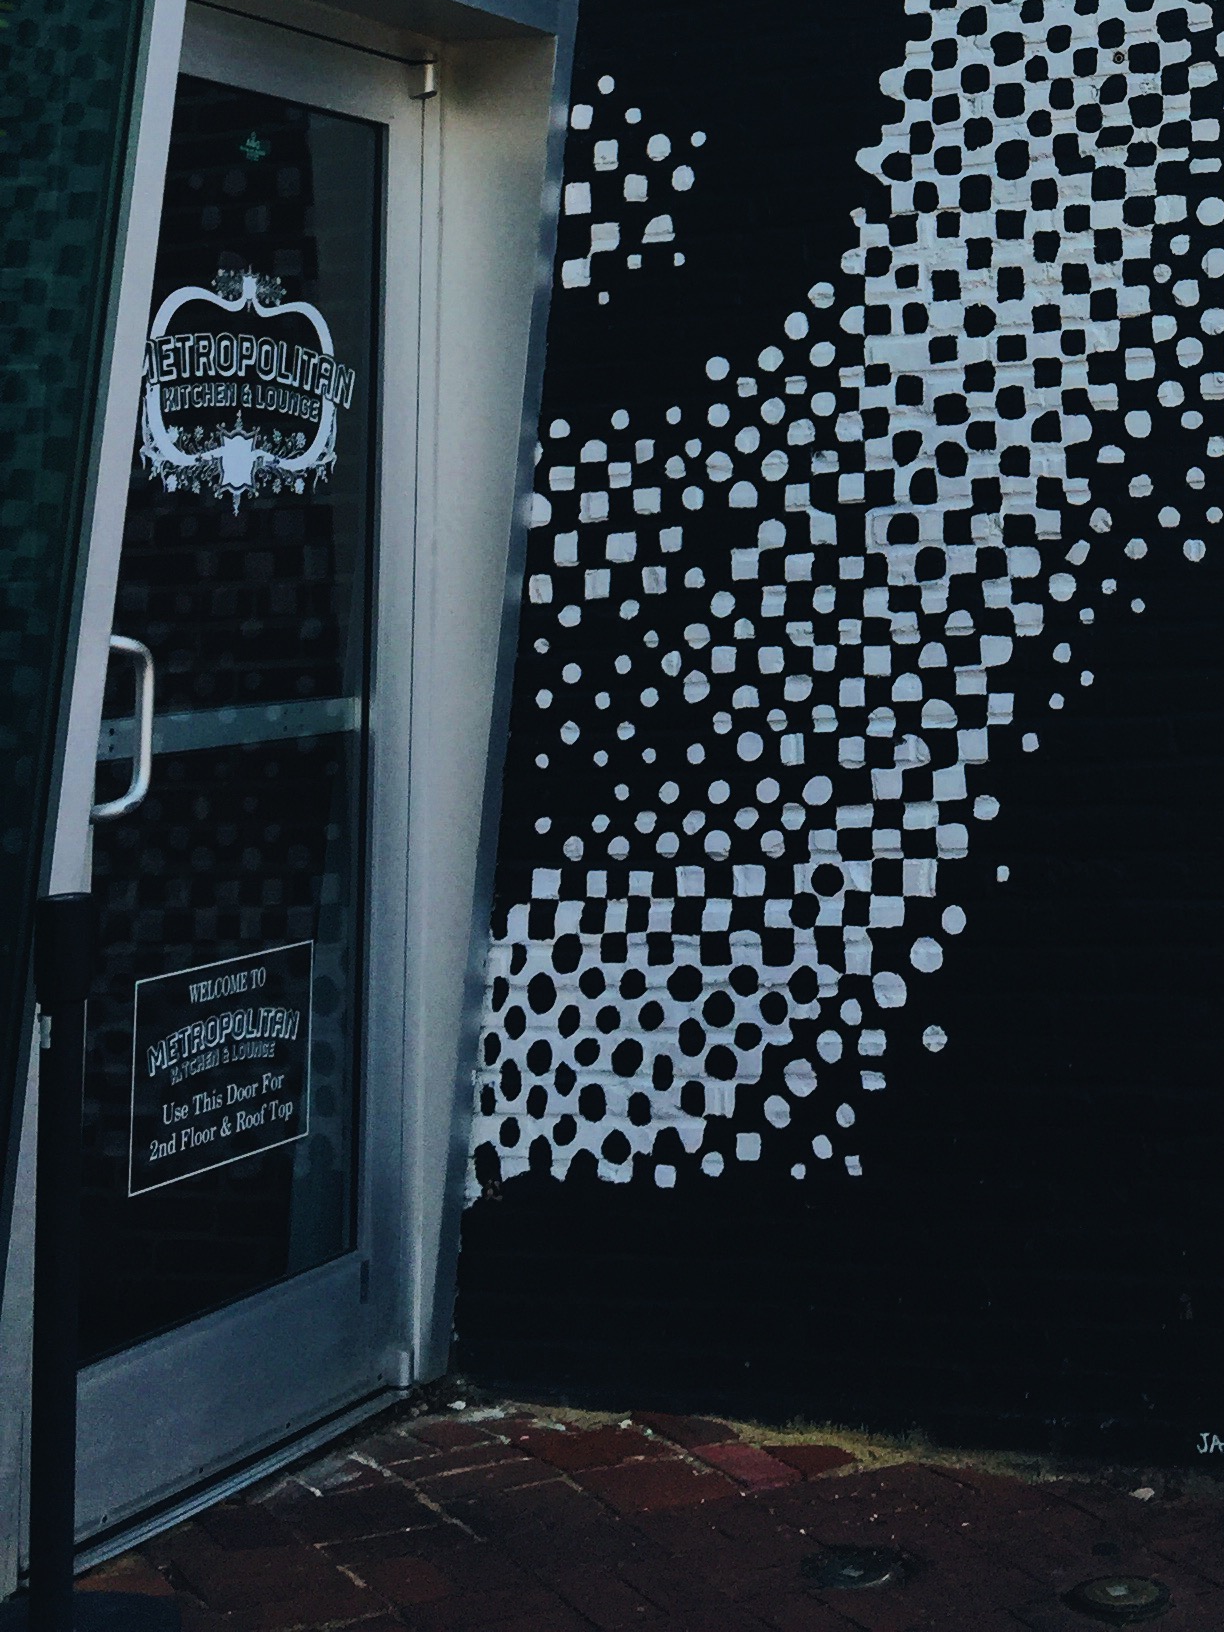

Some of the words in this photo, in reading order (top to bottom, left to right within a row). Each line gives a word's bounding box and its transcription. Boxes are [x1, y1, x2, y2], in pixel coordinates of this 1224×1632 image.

[162, 382, 237, 413] KITCHEN
[241, 384, 252, 408] &
[256, 385, 322, 423] LOUNGE
[189, 972, 248, 1003] WELCOME
[250, 967, 267, 989] TO
[147, 1007, 300, 1077] METROPOLITAN
[231, 1041, 276, 1062] LOUNGE
[162, 1103, 189, 1125] Use
[192, 1088, 223, 1116] This
[226, 1083, 259, 1107] Door
[261, 1071, 285, 1095] For
[149, 1133, 177, 1162] 2nd
[180, 1126, 217, 1151] Floor
[219, 1116, 232, 1137] &
[236, 1105, 268, 1133] Roof
[269, 1100, 294, 1122] Top
